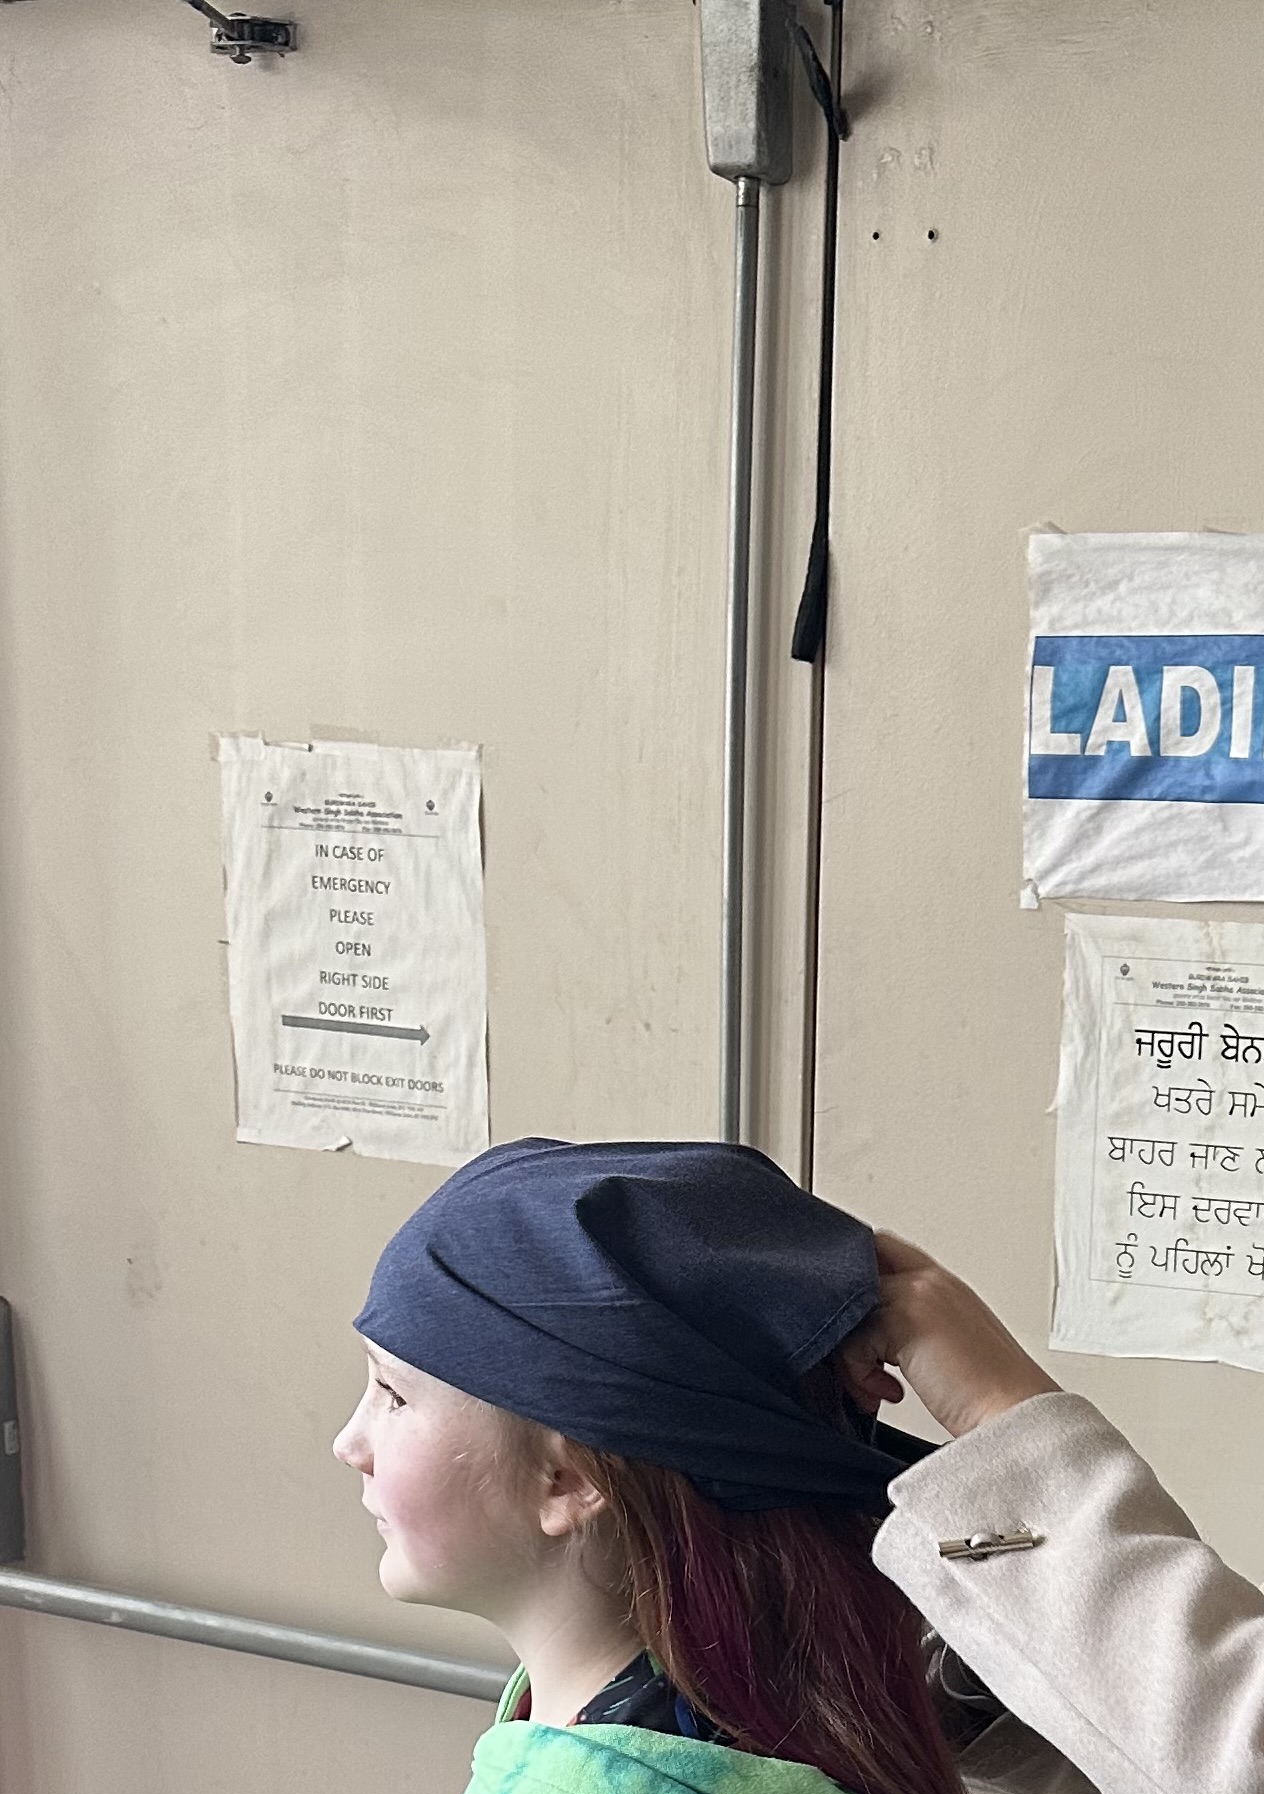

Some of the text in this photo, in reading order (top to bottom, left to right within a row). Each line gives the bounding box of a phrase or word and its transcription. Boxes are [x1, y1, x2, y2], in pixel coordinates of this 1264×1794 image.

[315, 844, 385, 862] IN CASE OF
[311, 875, 391, 895] EMERGENCY
[329, 908, 375, 926] PLEASE
[335, 941, 371, 957] OPEN
[319, 970, 389, 990] RIGHT SIDE
[1152, 981, 1185, 990] Western
[318, 1001, 393, 1022] DOOR FIRST
[1134, 1021, 1209, 1069] ਜਰੂਰੀ
[273, 1063, 444, 1093] PLEASE DO NOT BLOCK EXIT DOORS
[1152, 1078, 1216, 1116] ਖਤਰੇ
[1107, 1136, 1178, 1167] ਬਾਹਰ
[1189, 1143, 1244, 1172] ਜਾਣ
[1126, 1181, 1181, 1220] ਇਸ
[1115, 1232, 1139, 1278] ਨੂੰ
[1150, 1238, 1235, 1277] ਪਹਿਲਾਂ
